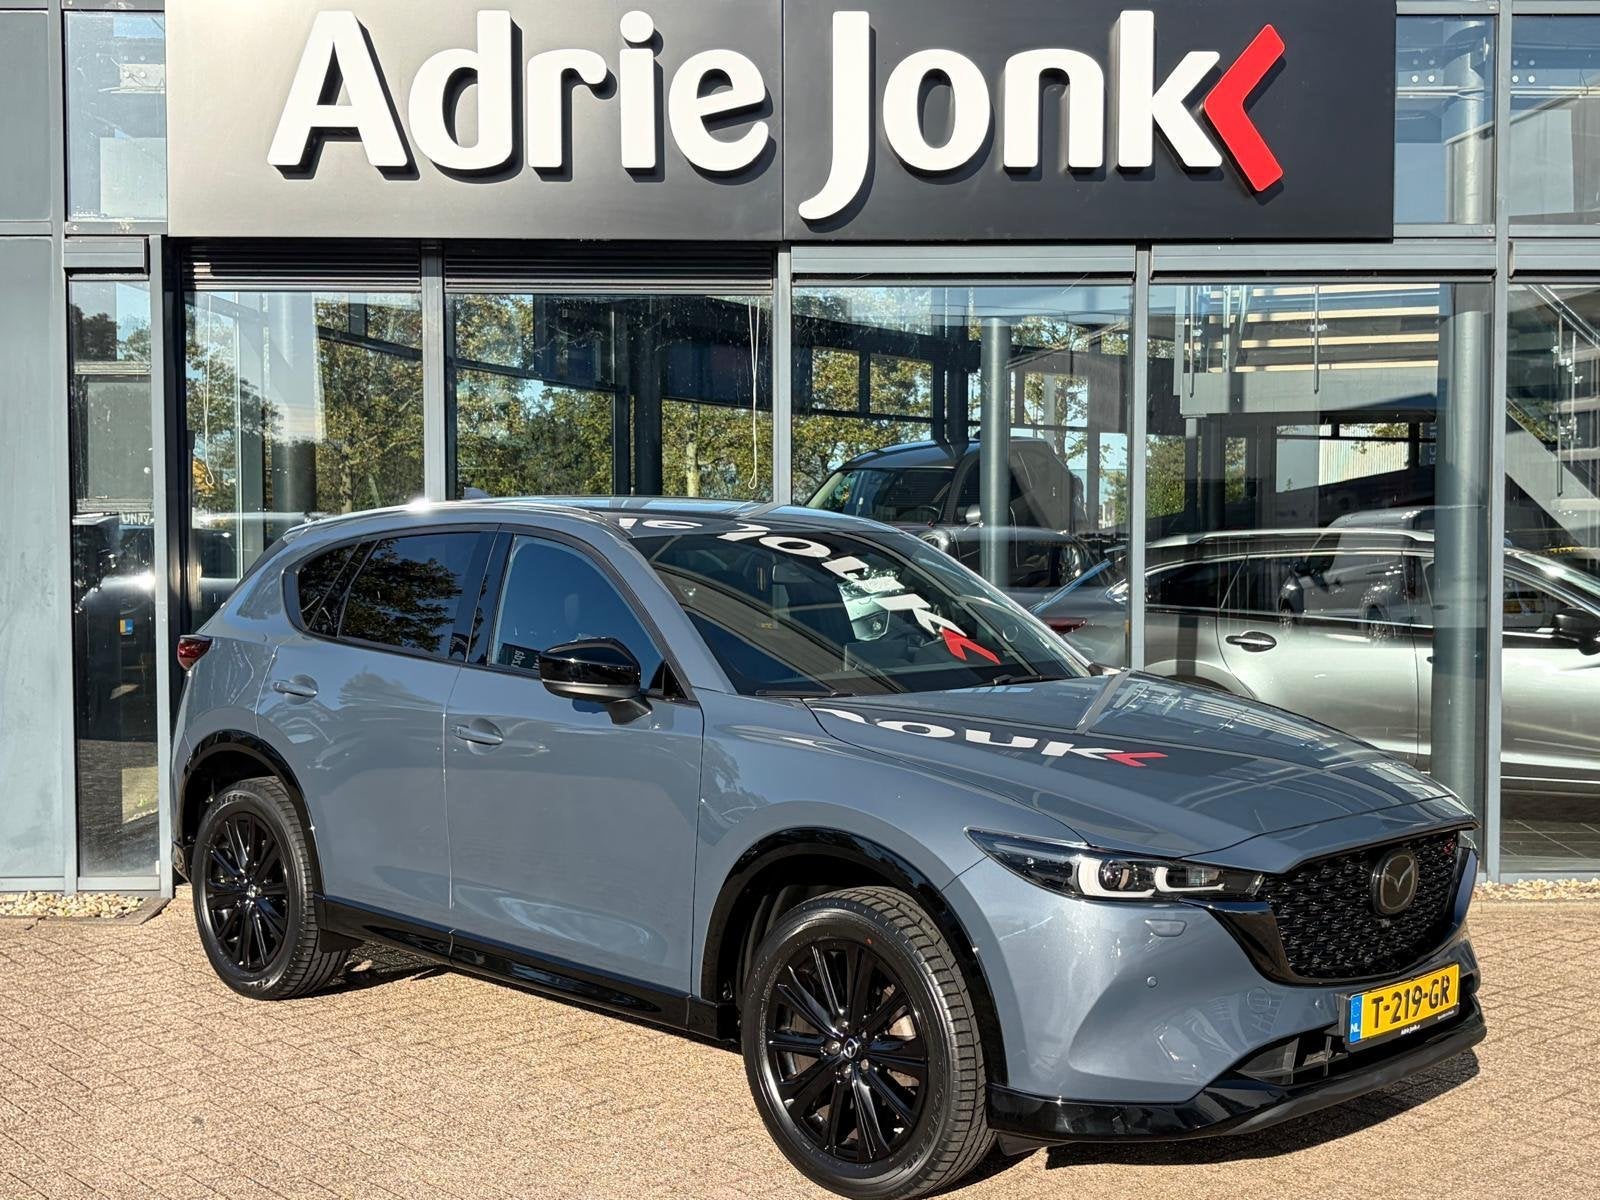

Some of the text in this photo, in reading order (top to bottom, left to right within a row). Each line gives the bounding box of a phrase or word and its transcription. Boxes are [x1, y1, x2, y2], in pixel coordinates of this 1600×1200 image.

[267, 9, 1223, 220] Adrie Jonk
[1351, 1023, 1361, 1034] NL
[1370, 975, 1450, 1029] T-219-GR
